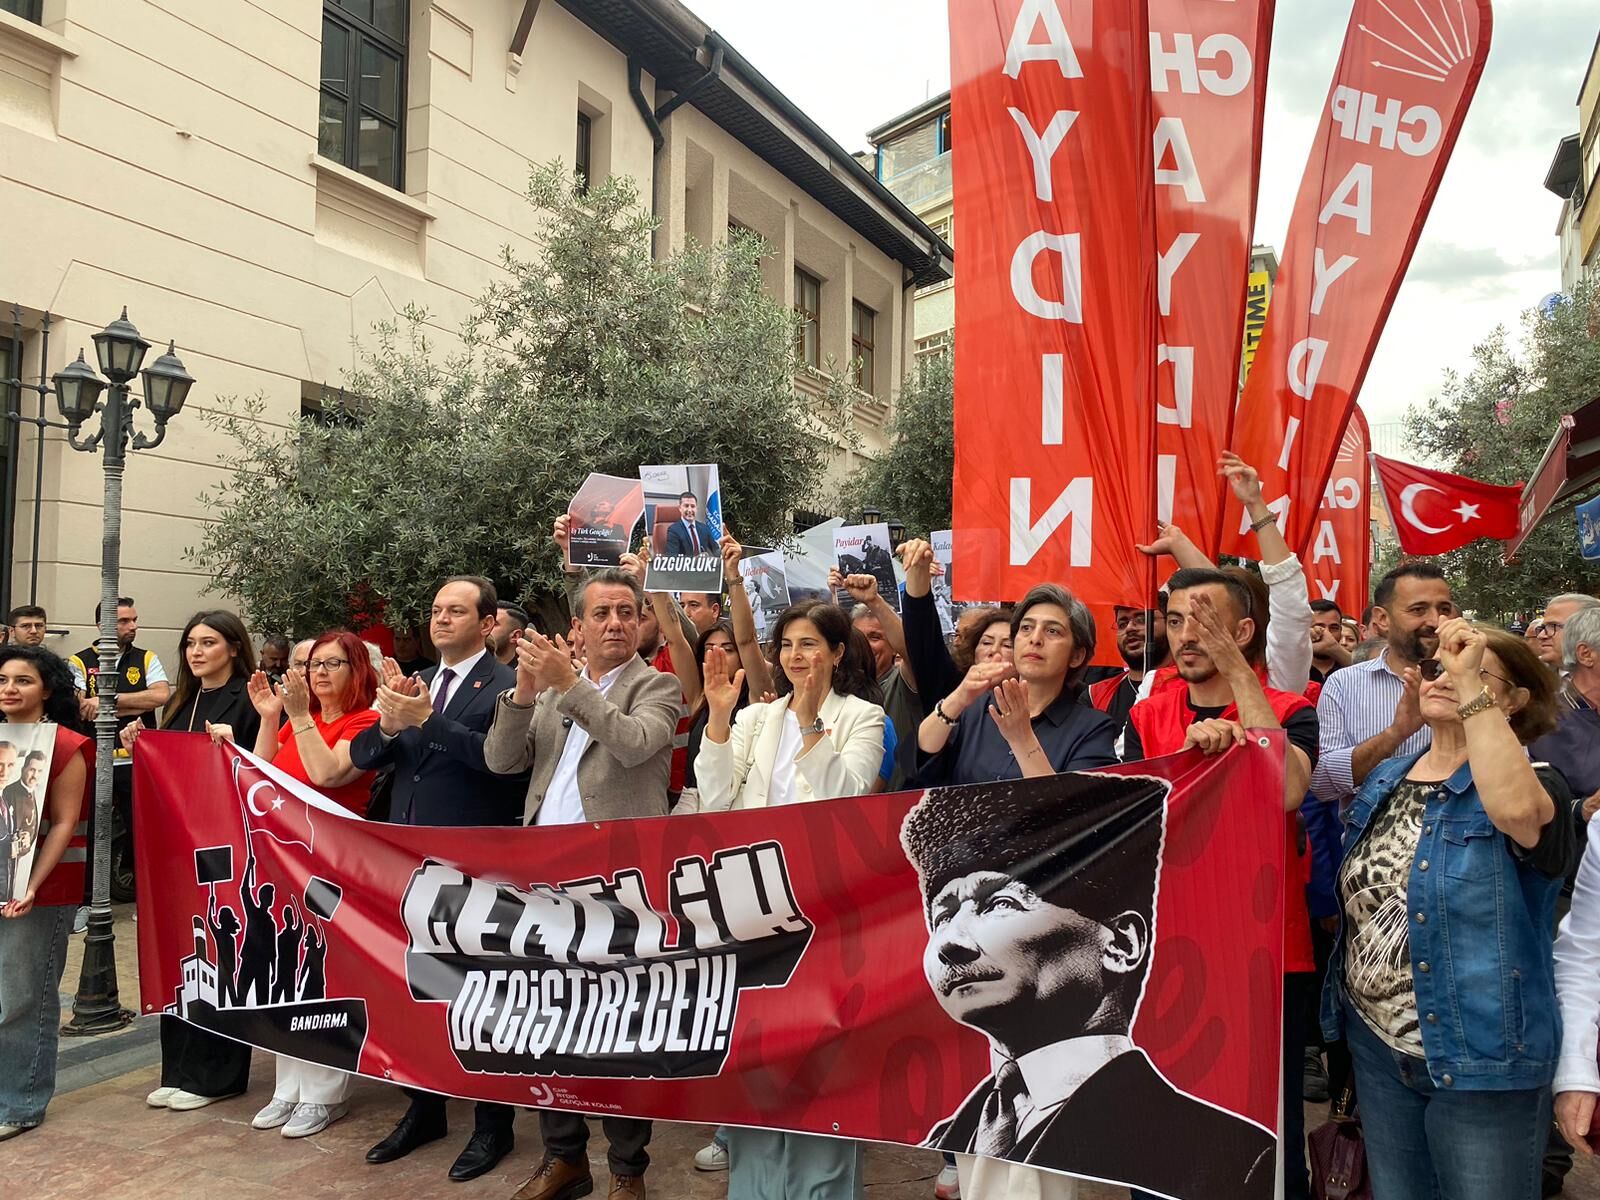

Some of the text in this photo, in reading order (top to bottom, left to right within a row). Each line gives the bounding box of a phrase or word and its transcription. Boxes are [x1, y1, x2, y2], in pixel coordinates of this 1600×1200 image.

[1247, 284, 1266, 375] TIME
[577, 527, 589, 535] Türk
[835, 536, 864, 549] Payidar
[653, 553, 719, 572] ÖZGÜRLÜK!
[290, 1012, 348, 1031] BANDIRMA
